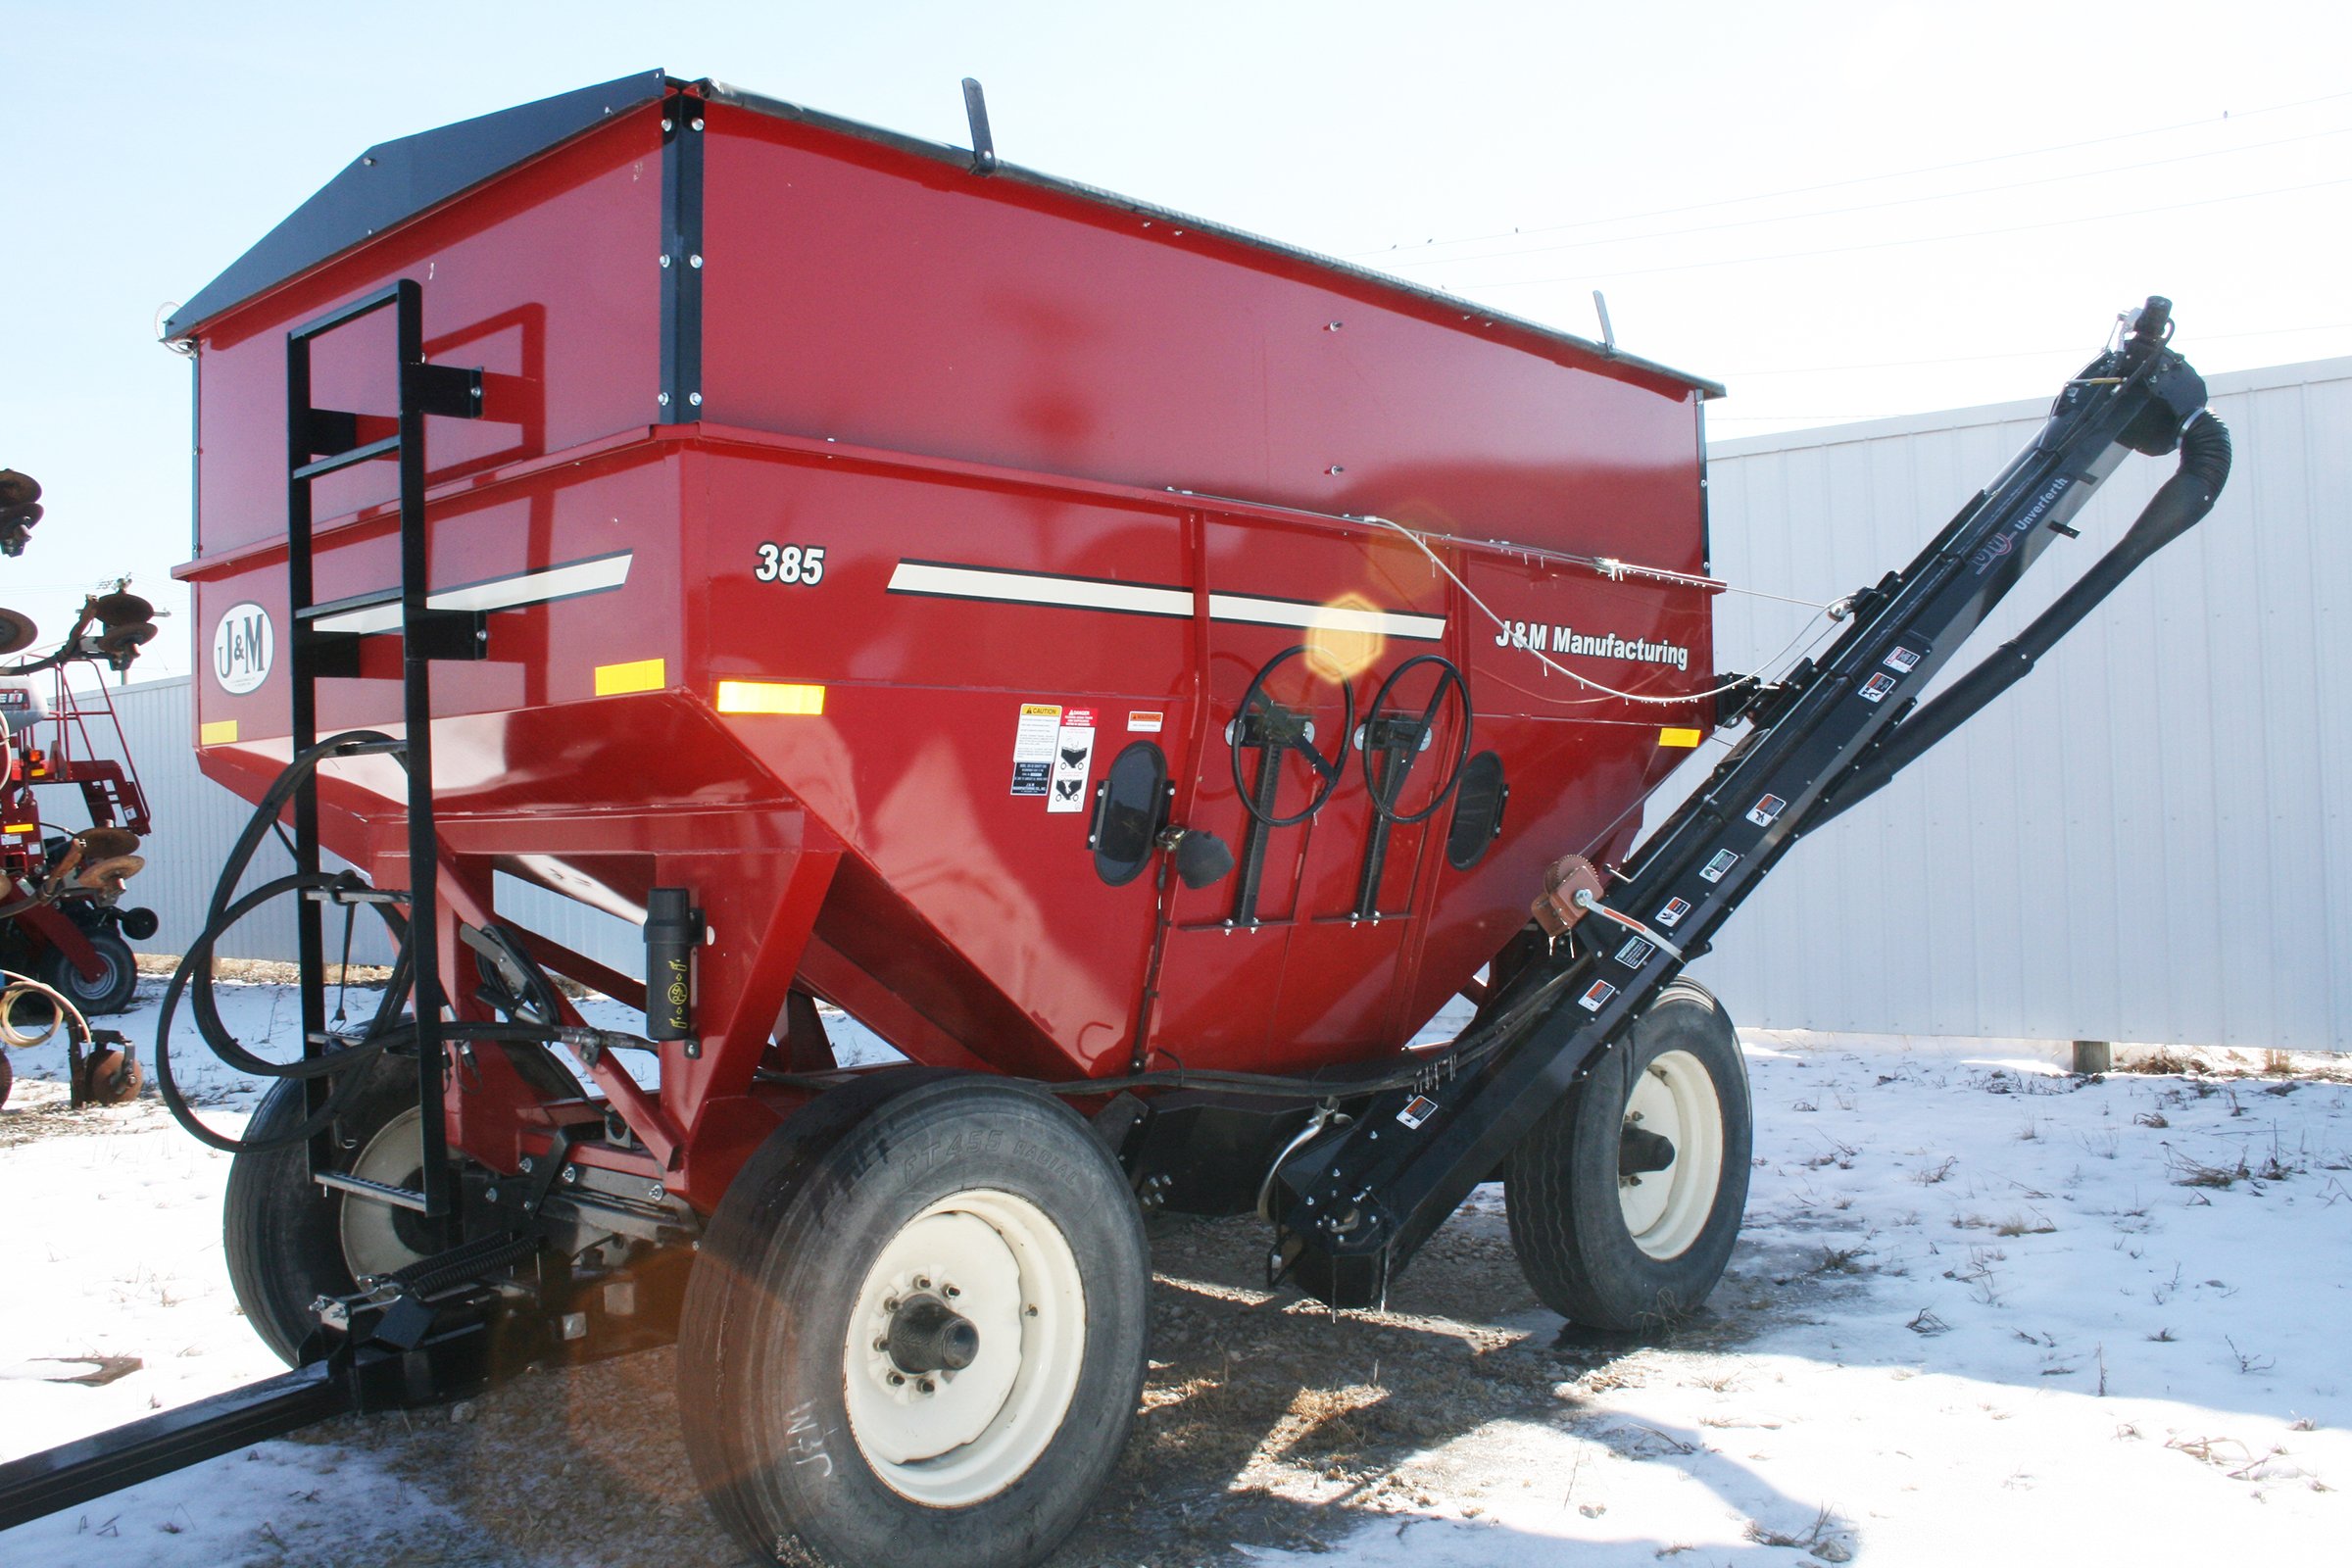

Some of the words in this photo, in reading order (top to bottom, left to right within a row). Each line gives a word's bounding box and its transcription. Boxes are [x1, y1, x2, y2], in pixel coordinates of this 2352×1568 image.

[2014, 476, 2070, 530] Unverferth
[754, 542, 826, 586] 385
[217, 612, 266, 679] J&M
[1495, 619, 1547, 651] J&M
[1552, 625, 1689, 671] Manufacturing
[1012, 1140, 1079, 1186] RADIAL
